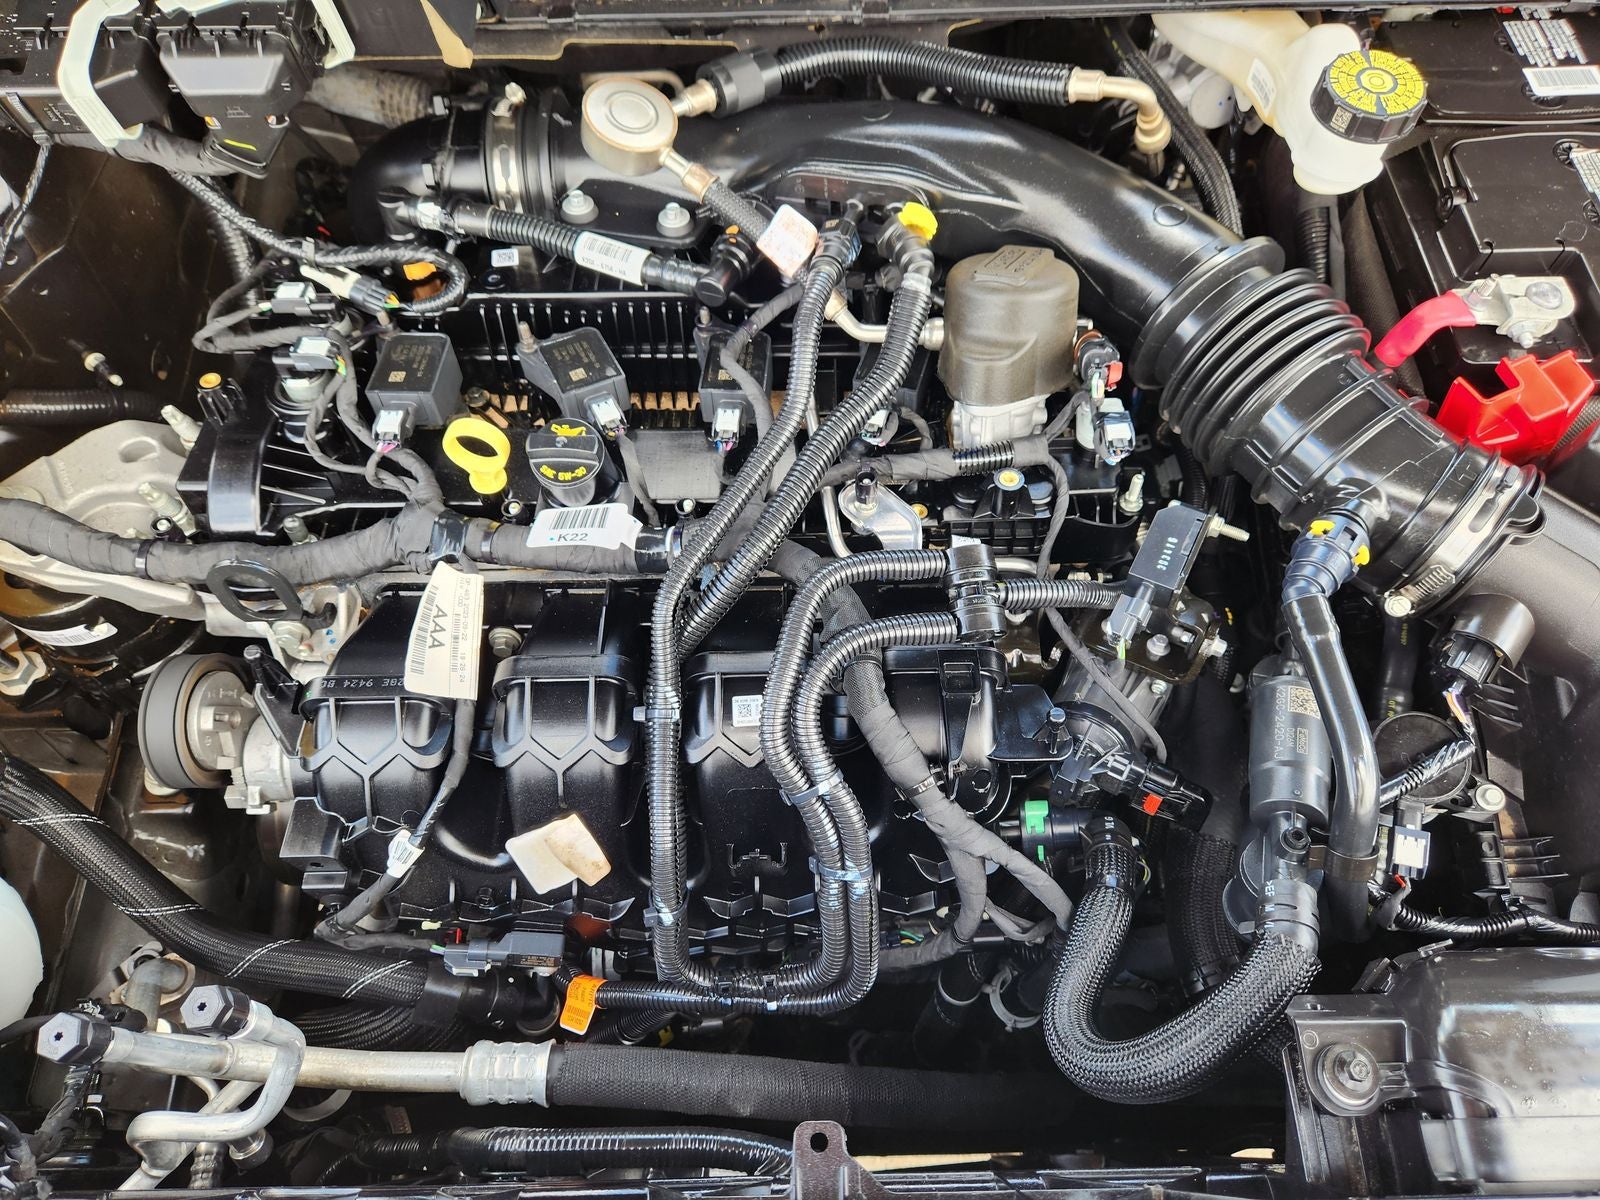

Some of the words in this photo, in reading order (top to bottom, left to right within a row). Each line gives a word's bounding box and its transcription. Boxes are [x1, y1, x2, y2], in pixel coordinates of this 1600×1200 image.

[540, 464, 557, 479] SAE
[558, 466, 587, 480] 5W-30
[557, 532, 589, 542] K22
[427, 604, 448, 649] AAA
[343, 679, 373, 688] 9424
